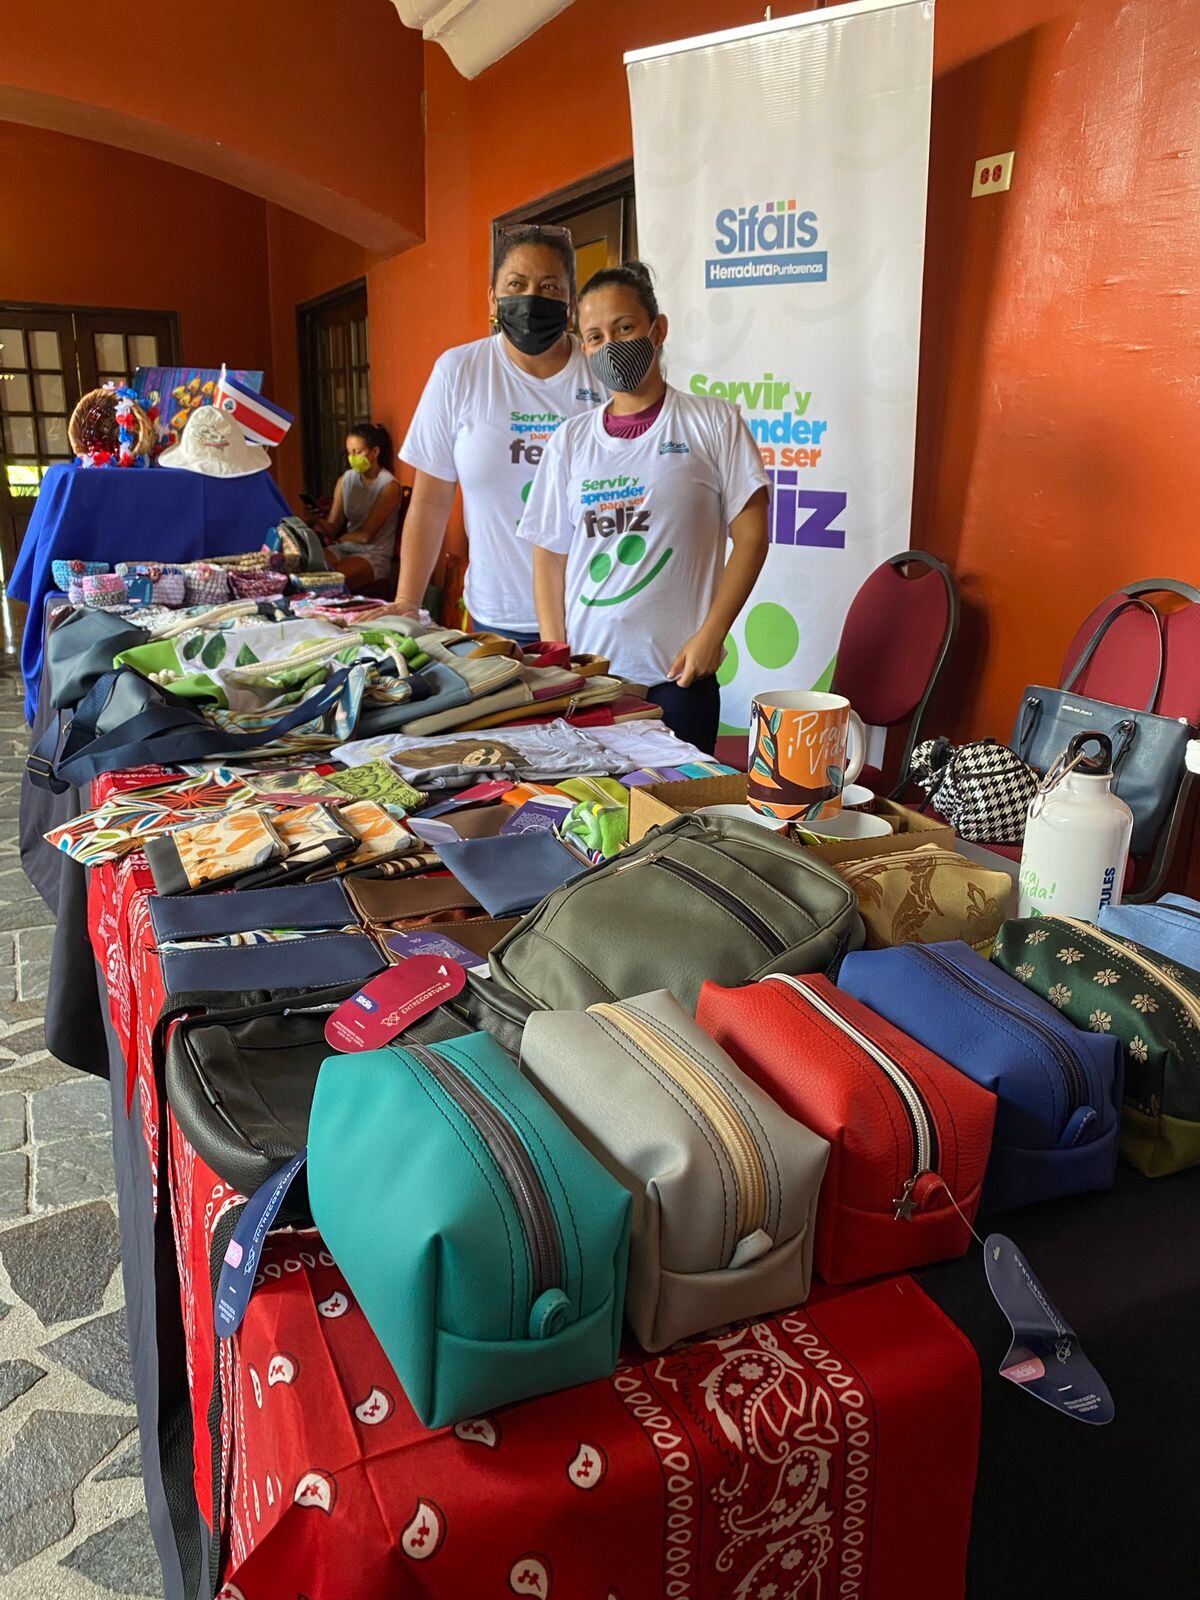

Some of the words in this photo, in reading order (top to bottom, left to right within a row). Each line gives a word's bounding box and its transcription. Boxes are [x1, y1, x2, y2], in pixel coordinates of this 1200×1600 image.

[690, 373, 790, 410] Servir
[794, 392, 812, 416] y
[510, 411, 559, 422] Servir
[747, 412, 827, 445] nder
[509, 438, 549, 465] fe
[781, 448, 821, 468] ser
[581, 475, 630, 492] Servir
[631, 477, 640, 486] y
[581, 485, 645, 505] aprender
[600, 501, 625, 512] para
[584, 506, 651, 538] feliz
[401, 982, 451, 1014] ENTRECOSTURAS
